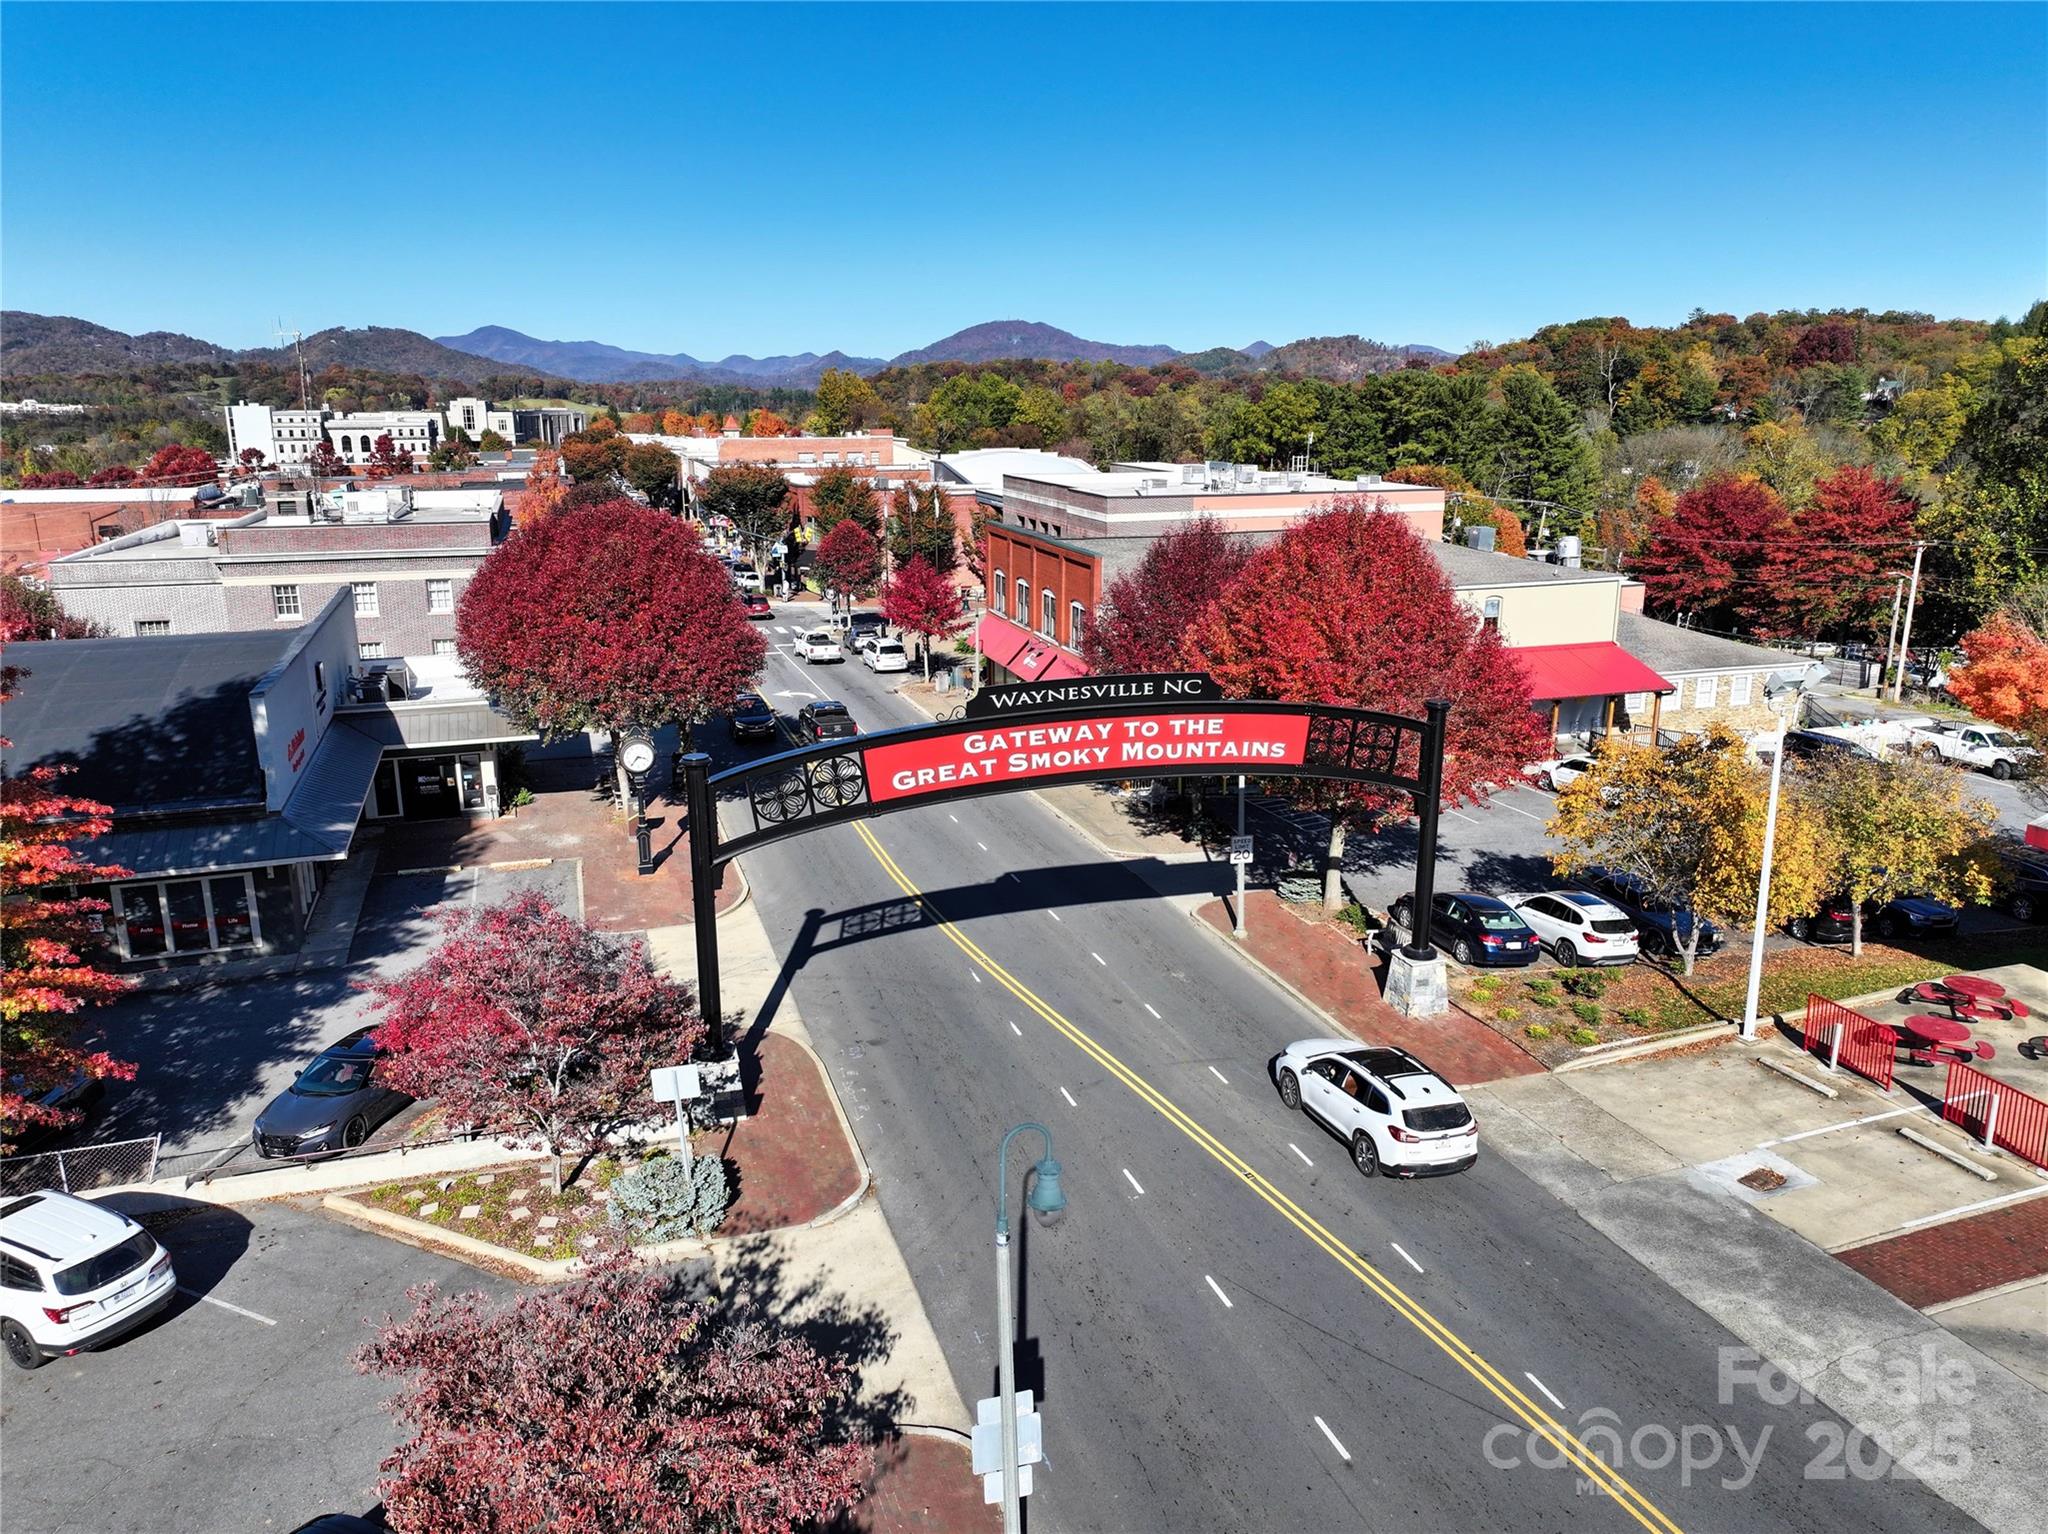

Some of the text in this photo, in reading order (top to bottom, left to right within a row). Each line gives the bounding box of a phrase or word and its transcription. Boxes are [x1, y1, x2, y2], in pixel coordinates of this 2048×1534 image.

[989, 679, 1202, 709] WAYNESVILLE NC
[963, 718, 1224, 754] GATEWAY TO THE
[892, 740, 1286, 791] GREAT SMOKY MOUNTAINS
[1233, 850, 1250, 860] 20
